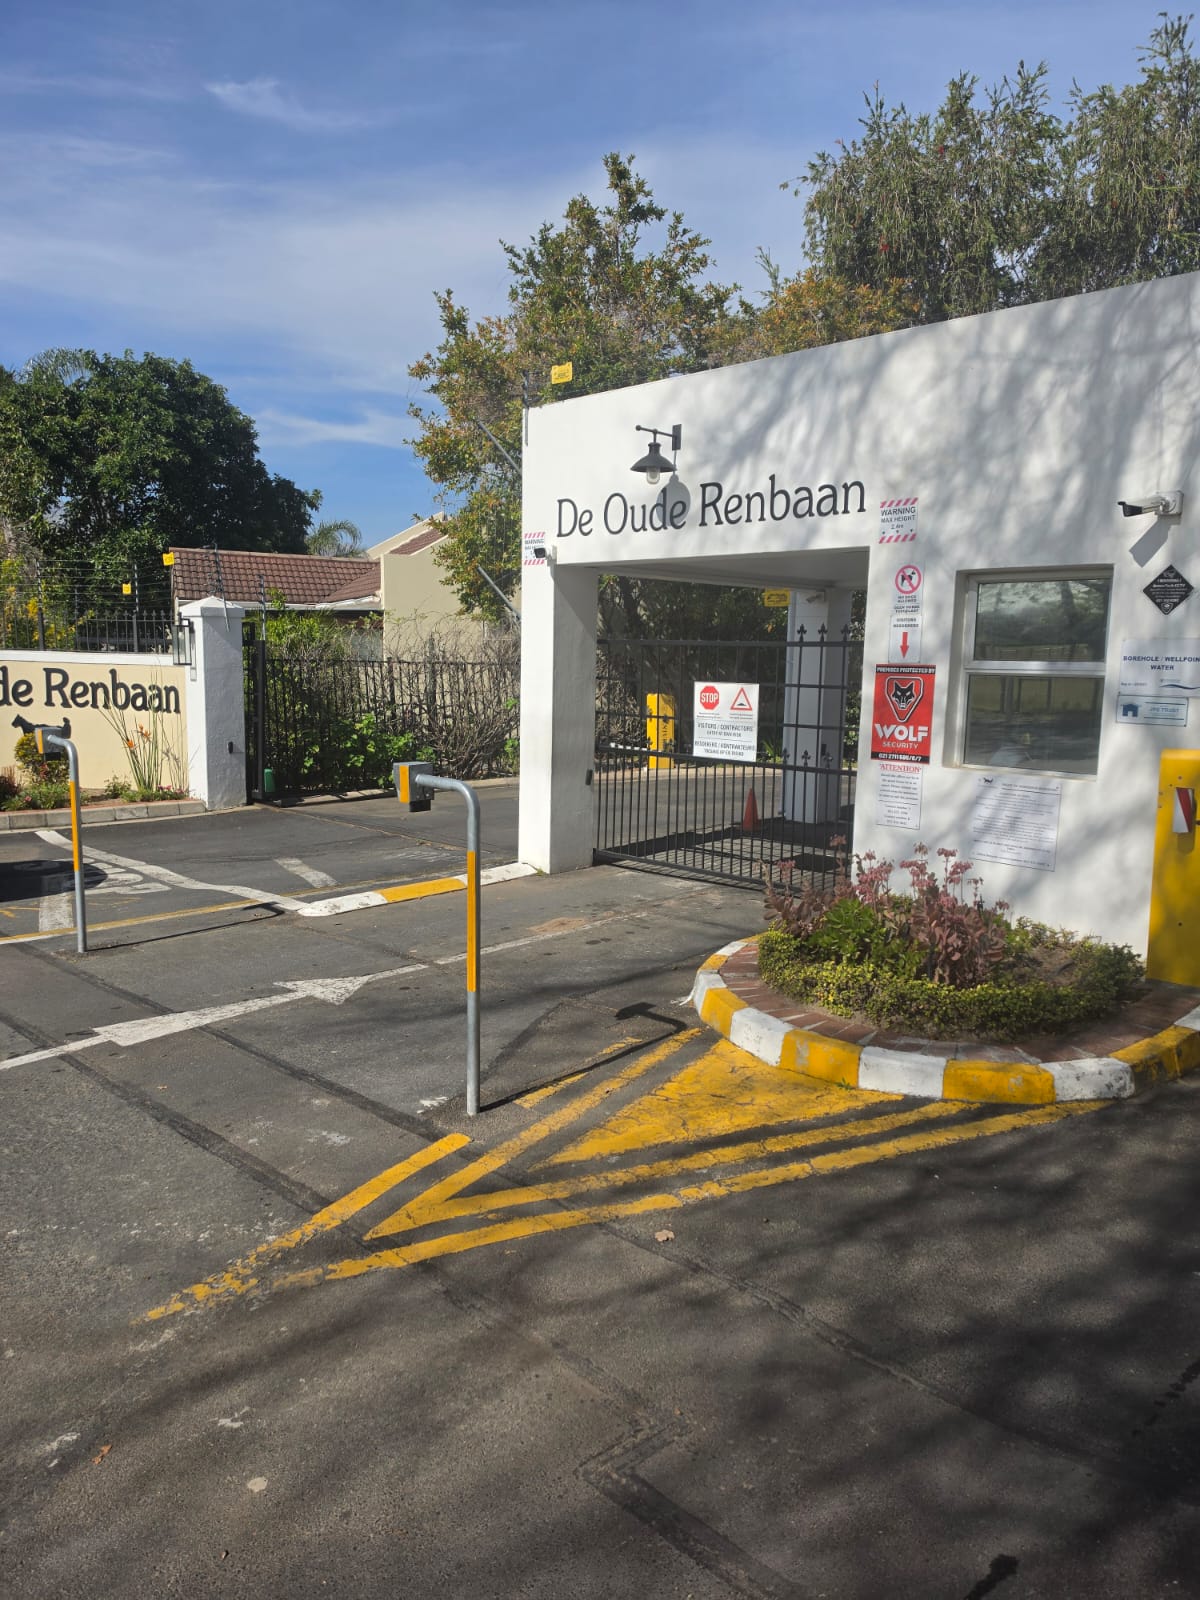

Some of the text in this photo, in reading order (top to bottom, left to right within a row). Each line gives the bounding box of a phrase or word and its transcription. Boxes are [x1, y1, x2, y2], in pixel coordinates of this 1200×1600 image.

[557, 474, 866, 538] De Oude Renbaan
[880, 506, 916, 516] WARNING
[894, 514, 915, 522] HEIGHT
[1123, 655, 1160, 663] BOREHOLE
[43, 667, 181, 713] Renbaan
[701, 692, 719, 704] STOP
[720, 724, 753, 732] CONTRACTORS
[874, 723, 929, 742] WOLF
[882, 741, 918, 749] SECURITY
